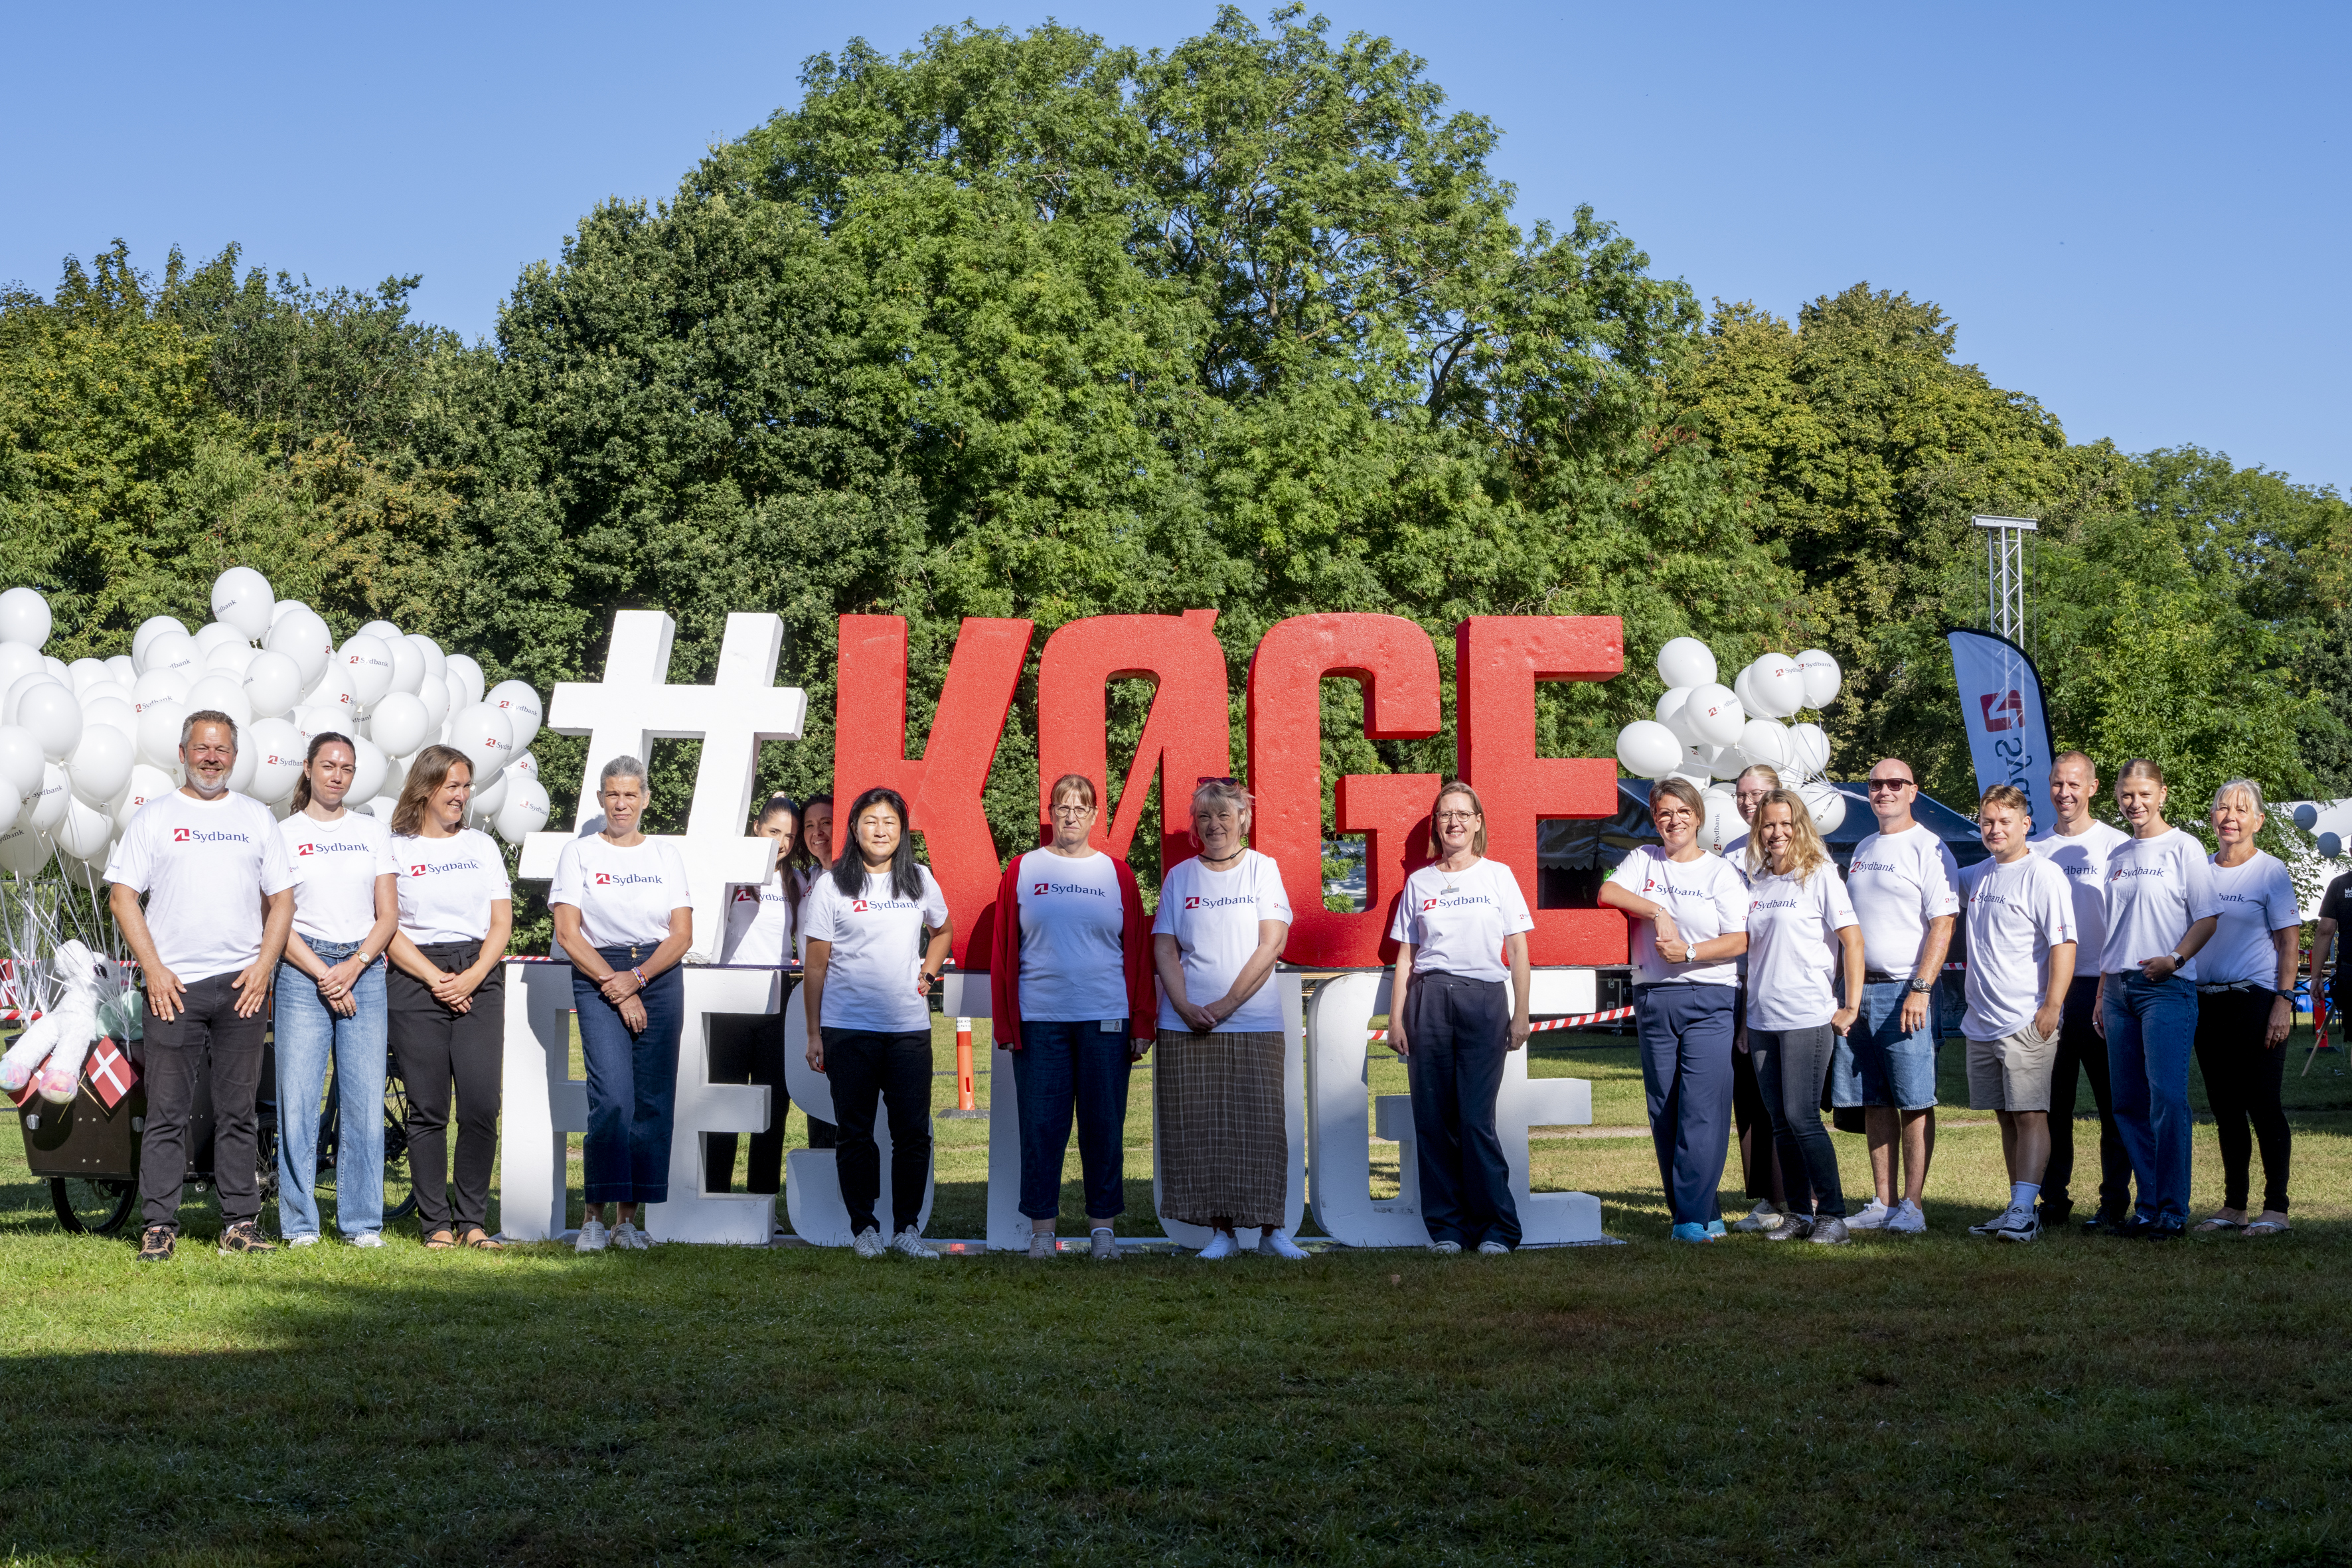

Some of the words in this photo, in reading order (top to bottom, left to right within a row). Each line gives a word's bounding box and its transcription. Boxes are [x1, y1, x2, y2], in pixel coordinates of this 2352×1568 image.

[214, 599, 237, 617] Sydbank
[167, 659, 191, 669] dbank
[279, 758, 303, 767] Sydban
[0, 830, 25, 844] ydbank
[193, 830, 250, 843] Sydbank
[315, 842, 370, 854] Sydbank
[428, 861, 479, 874] Sydbank
[1859, 862, 1895, 872] Sydbank
[2064, 866, 2098, 875] dbank
[2121, 867, 2165, 879] Sydbank
[613, 874, 663, 886] Sydbank
[1051, 884, 1106, 897] Sydbank
[1656, 884, 1704, 898] Sydbank
[869, 900, 920, 911] Sydbank
[1202, 895, 1255, 909] Sydbank
[1439, 896, 1491, 908] Sydbank
[1757, 899, 1797, 910] Sydbank
